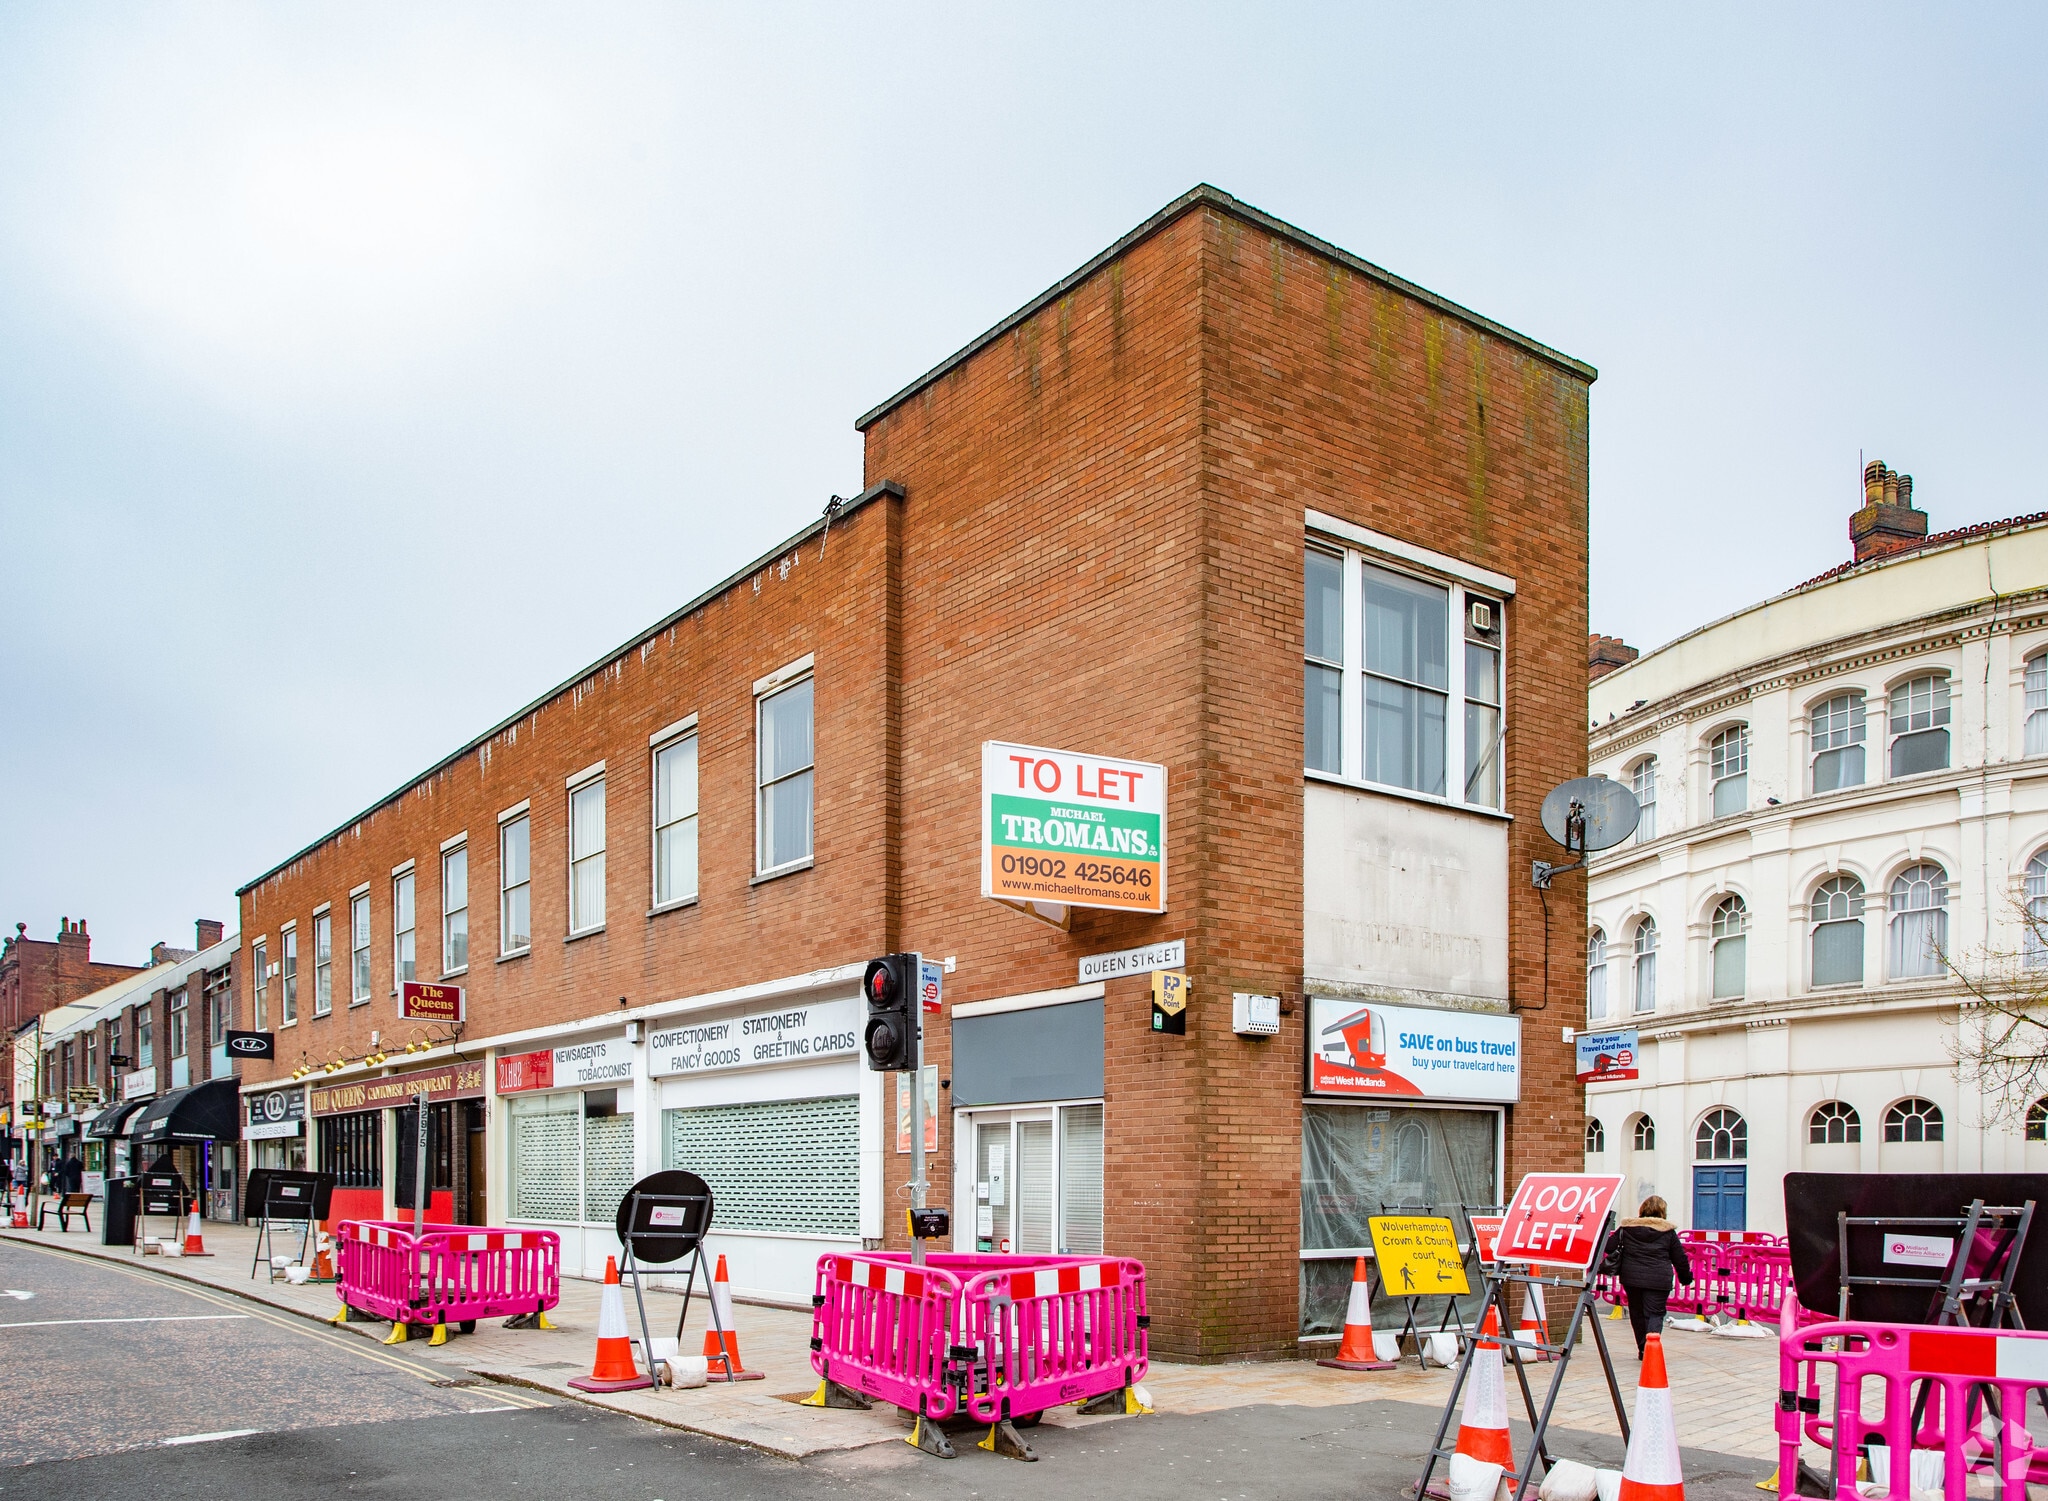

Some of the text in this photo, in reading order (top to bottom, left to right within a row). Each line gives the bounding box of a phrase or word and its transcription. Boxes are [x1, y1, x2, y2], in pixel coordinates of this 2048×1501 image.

[1009, 755, 1143, 803] TO LET
[1050, 806, 1106, 823] MICHAEL
[1001, 813, 1148, 856] TROMANS
[1001, 854, 1152, 887] 01902 425646
[1001, 878, 1151, 902] www.michaeltromans.co.uk
[1084, 946, 1180, 976] QUEEN STREET
[925, 974, 938, 982] here
[419, 985, 444, 998] The
[1163, 990, 1175, 1000] Pay
[409, 995, 454, 1010] Queens
[1163, 999, 1180, 1009] Point
[409, 1008, 454, 1020] Restaurant
[742, 1010, 808, 1036] STATIONERY
[652, 1024, 729, 1049] CONFECTIONERY
[777, 1031, 783, 1041] &
[1399, 1032, 1516, 1057] SAVE on bus travel
[1605, 1035, 1620, 1043] your
[555, 1043, 607, 1064] NEWSAGENTS
[697, 1043, 702, 1053] &
[753, 1031, 855, 1061] GREETING CARDS
[1582, 1044, 1601, 1052] Travel
[671, 1047, 741, 1071] FANCY GOODS
[1412, 1056, 1516, 1073] buy your travelcard here
[577, 1062, 632, 1082] TOBACCONIST
[1335, 1075, 1386, 1088] West Midlands
[312, 1090, 329, 1112] THE
[331, 1084, 366, 1112] QUEENS
[367, 1083, 404, 1101] CANTONESE
[405, 1075, 453, 1095] RESTAURANT
[420, 1100, 429, 1148] B2975
[1519, 1185, 1607, 1213] LOOK
[1380, 1222, 1449, 1233] Wolverhampton
[1382, 1235, 1453, 1248] Crown & County
[1512, 1221, 1583, 1252] LEFT
[1412, 1250, 1437, 1260] court
[1437, 1257, 1464, 1270] Metro
